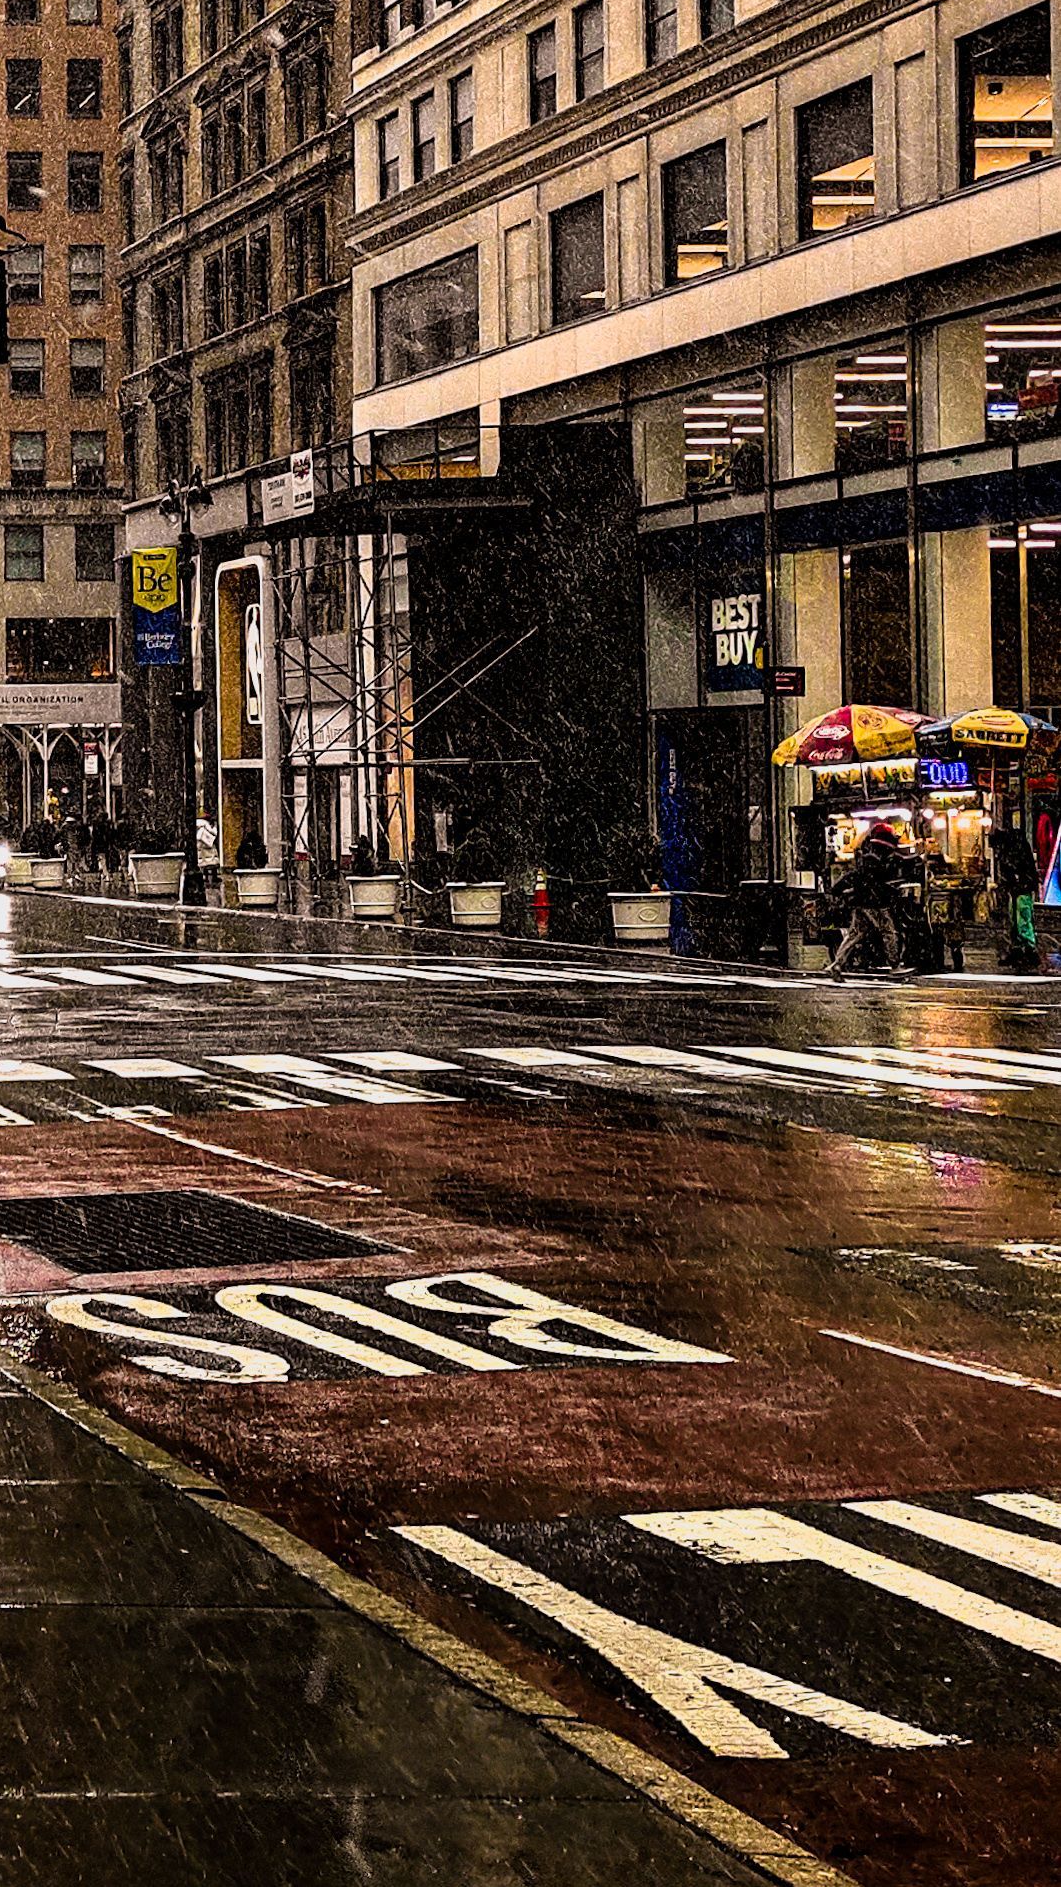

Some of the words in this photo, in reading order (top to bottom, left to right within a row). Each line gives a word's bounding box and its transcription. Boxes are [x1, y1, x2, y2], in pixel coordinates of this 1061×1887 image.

[137, 565, 173, 593] Be
[712, 593, 762, 632] BEST
[716, 630, 759, 667] BUY
[12, 695, 84, 704] ORGANIZATION
[45, 1270, 736, 1385] BUS
